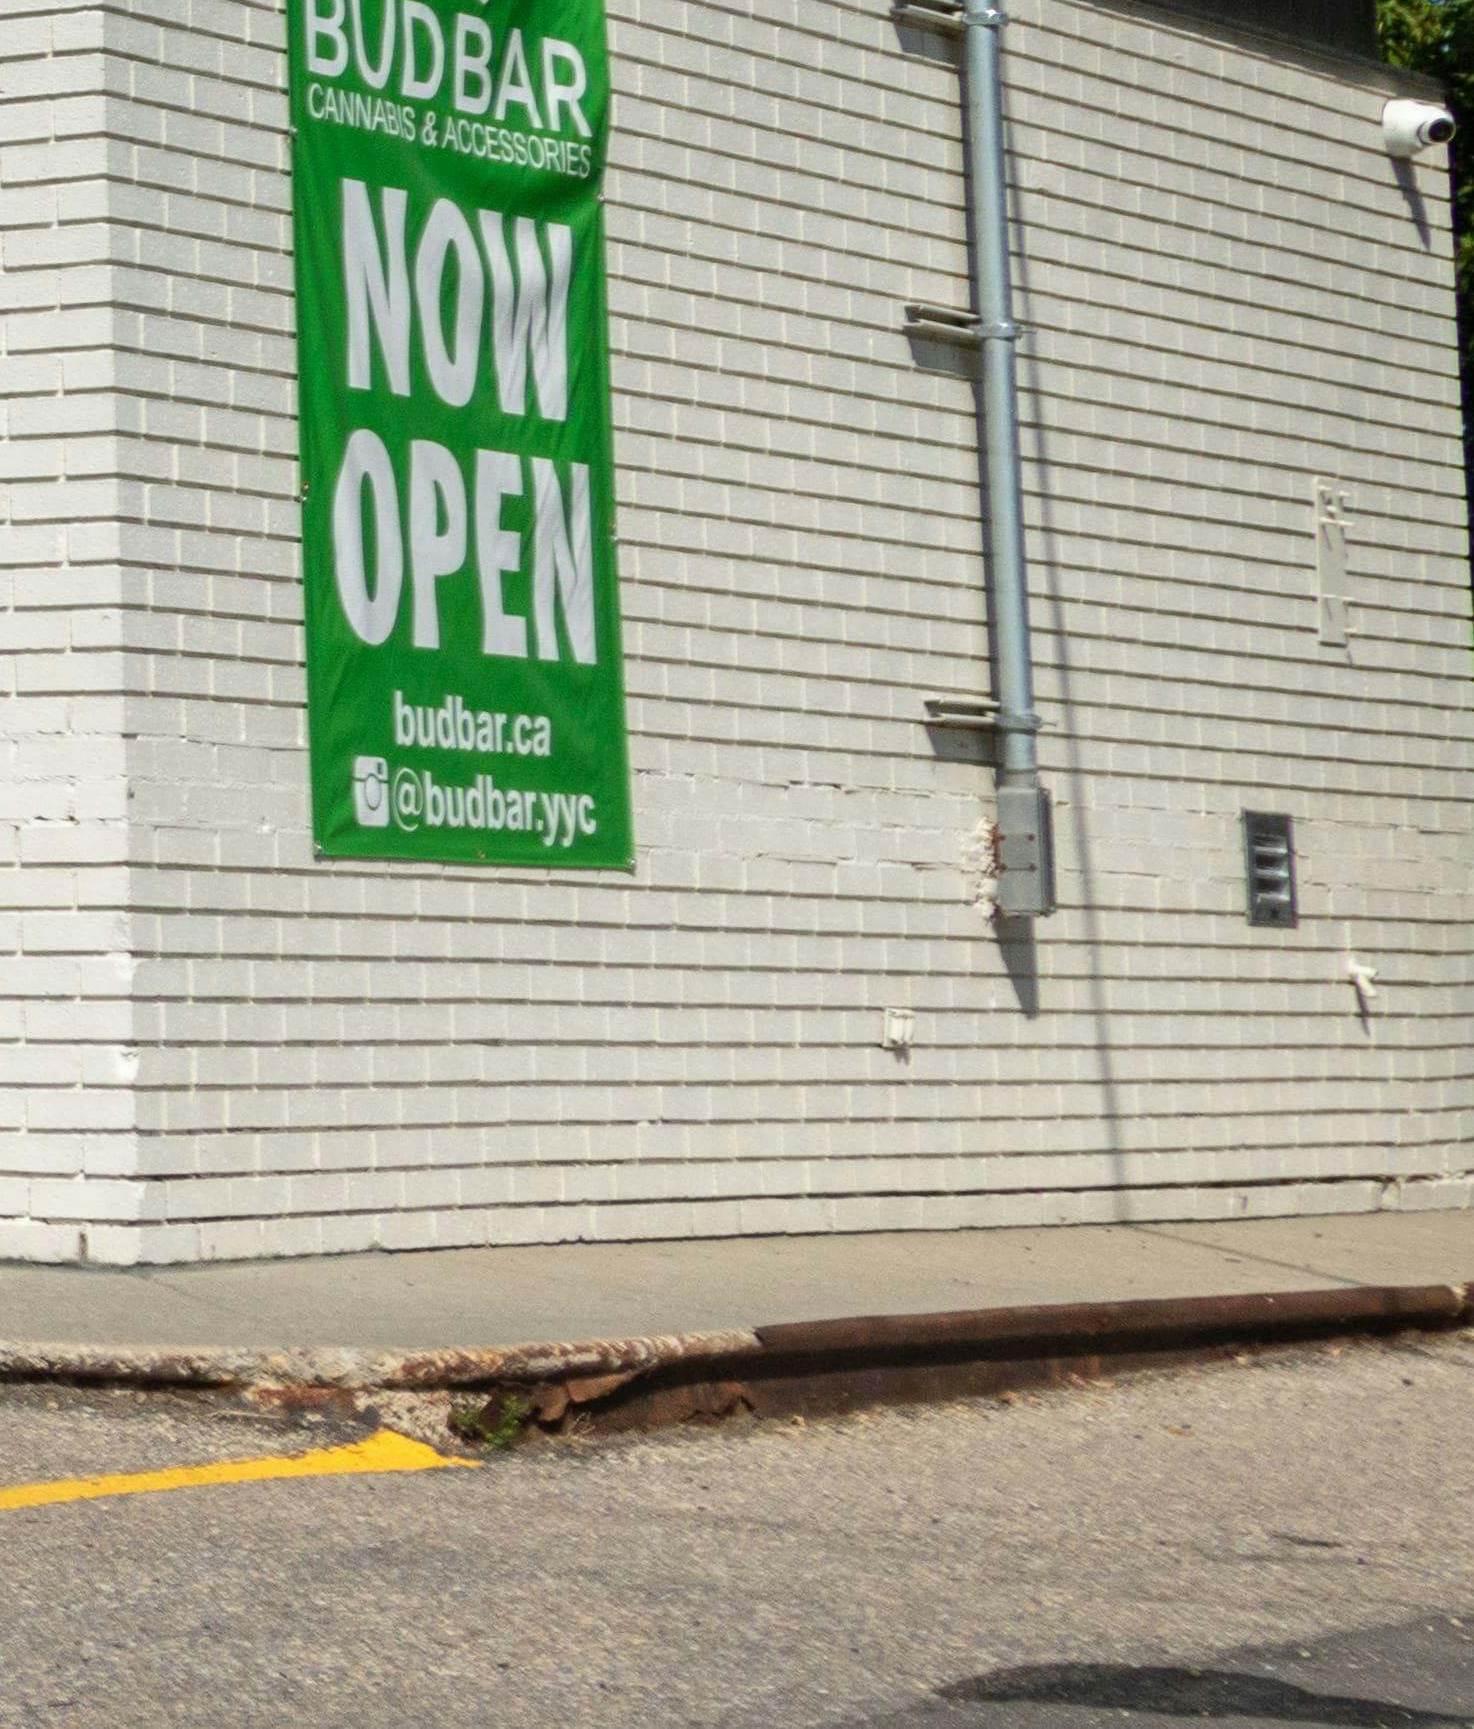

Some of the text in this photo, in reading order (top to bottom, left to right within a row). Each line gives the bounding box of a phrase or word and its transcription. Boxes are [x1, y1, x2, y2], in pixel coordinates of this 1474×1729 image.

[455, 12, 593, 138] BAR
[307, 83, 592, 179] CANNABIS & ACCESSORIES
[341, 177, 572, 421] NOW
[333, 428, 598, 665] OPEN
[393, 690, 552, 757] budbar.ca
[392, 767, 597, 848] @budbar.yyc
